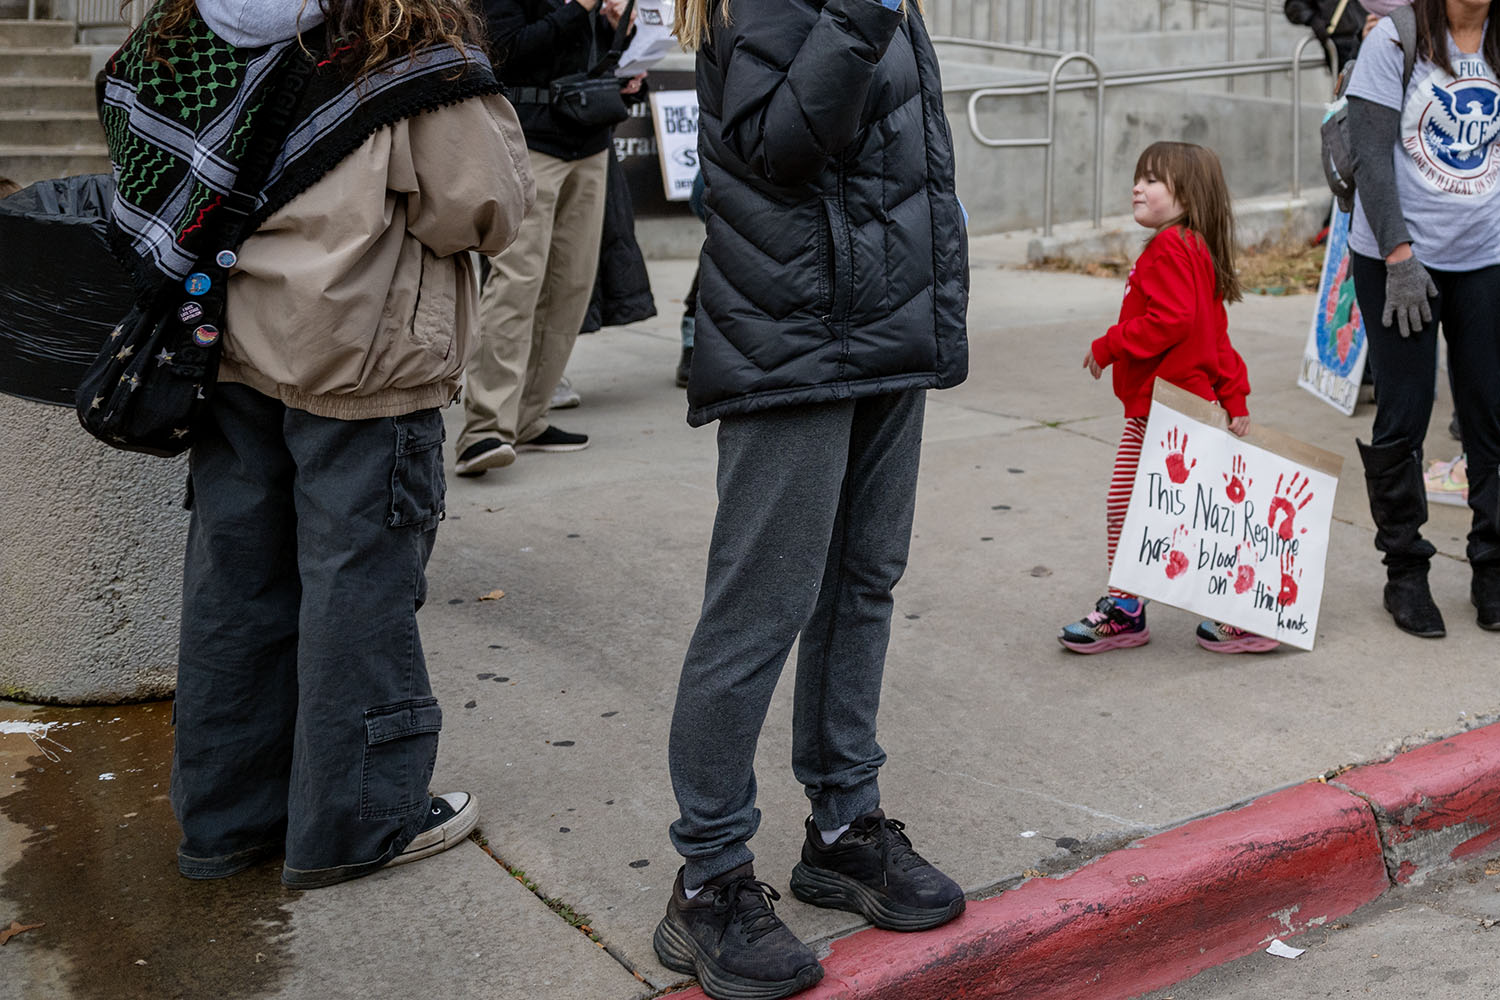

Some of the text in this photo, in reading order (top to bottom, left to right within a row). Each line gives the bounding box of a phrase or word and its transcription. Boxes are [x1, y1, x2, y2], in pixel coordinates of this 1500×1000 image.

[1457, 120, 1491, 145] ICE
[1403, 135, 1418, 152] NO
[1411, 151, 1428, 170] ONE
[1424, 168, 1436, 181] IS
[1435, 174, 1474, 195] ILLEGAL
[1147, 472, 1300, 562] This Nazi Regime
[1138, 526, 1239, 570] has blood
[1207, 574, 1228, 596] on
[1277, 612, 1309, 635] hands
